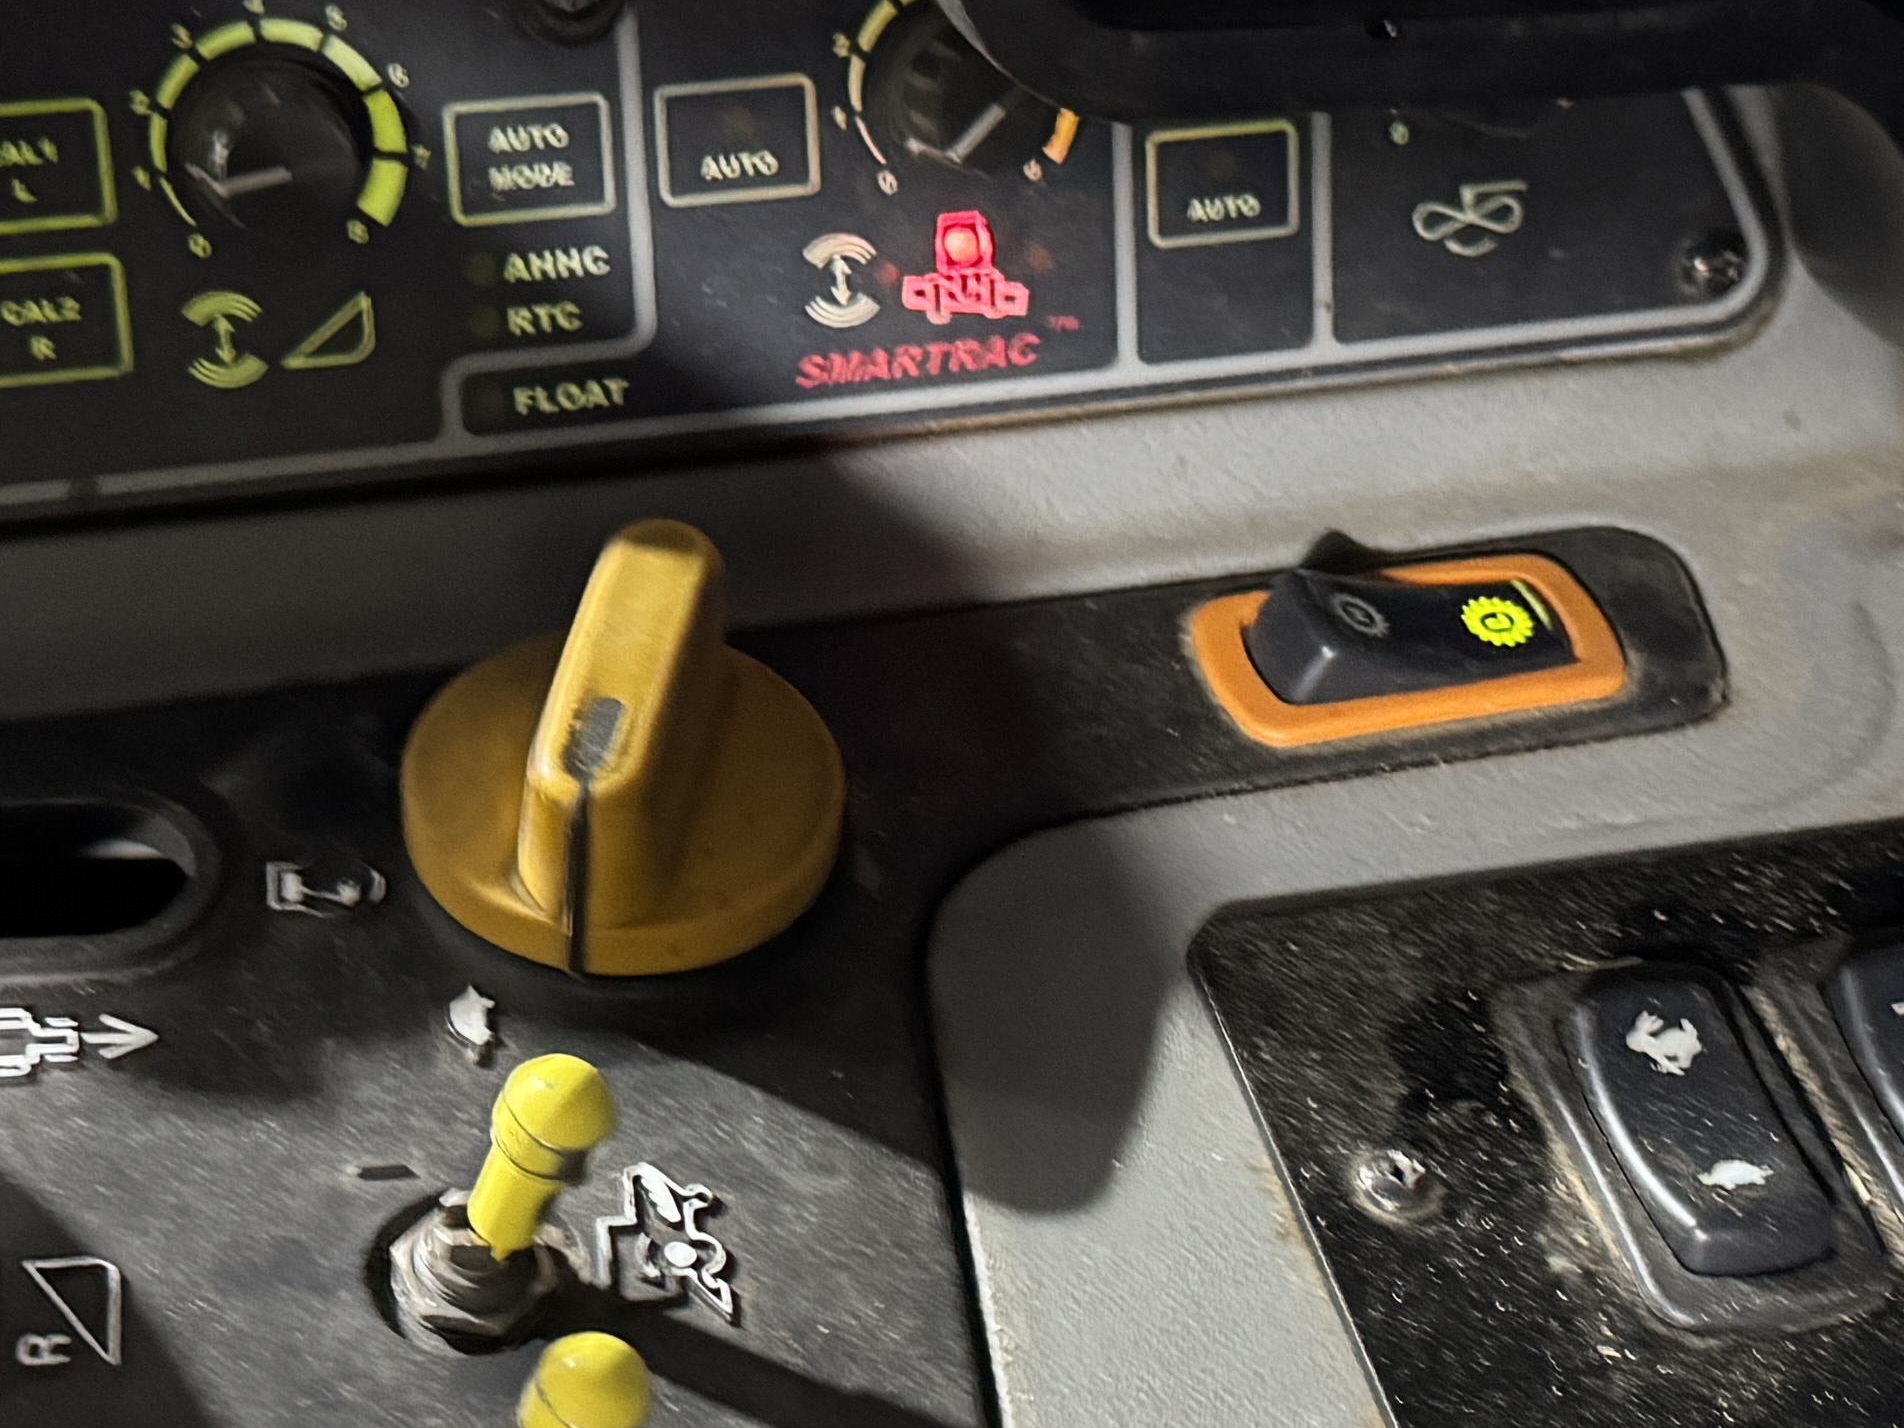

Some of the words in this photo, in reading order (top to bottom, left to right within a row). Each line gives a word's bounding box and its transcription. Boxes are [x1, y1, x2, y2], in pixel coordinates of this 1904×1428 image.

[487, 122, 571, 154] AUTO
[487, 160, 577, 193] MODE
[699, 149, 780, 181] AUTO
[10, 177, 39, 205] L
[1185, 192, 1261, 224] AUTO
[507, 300, 584, 337] RTC
[796, 331, 1041, 389] SMARTRAC
[512, 377, 631, 416] FLOAT
